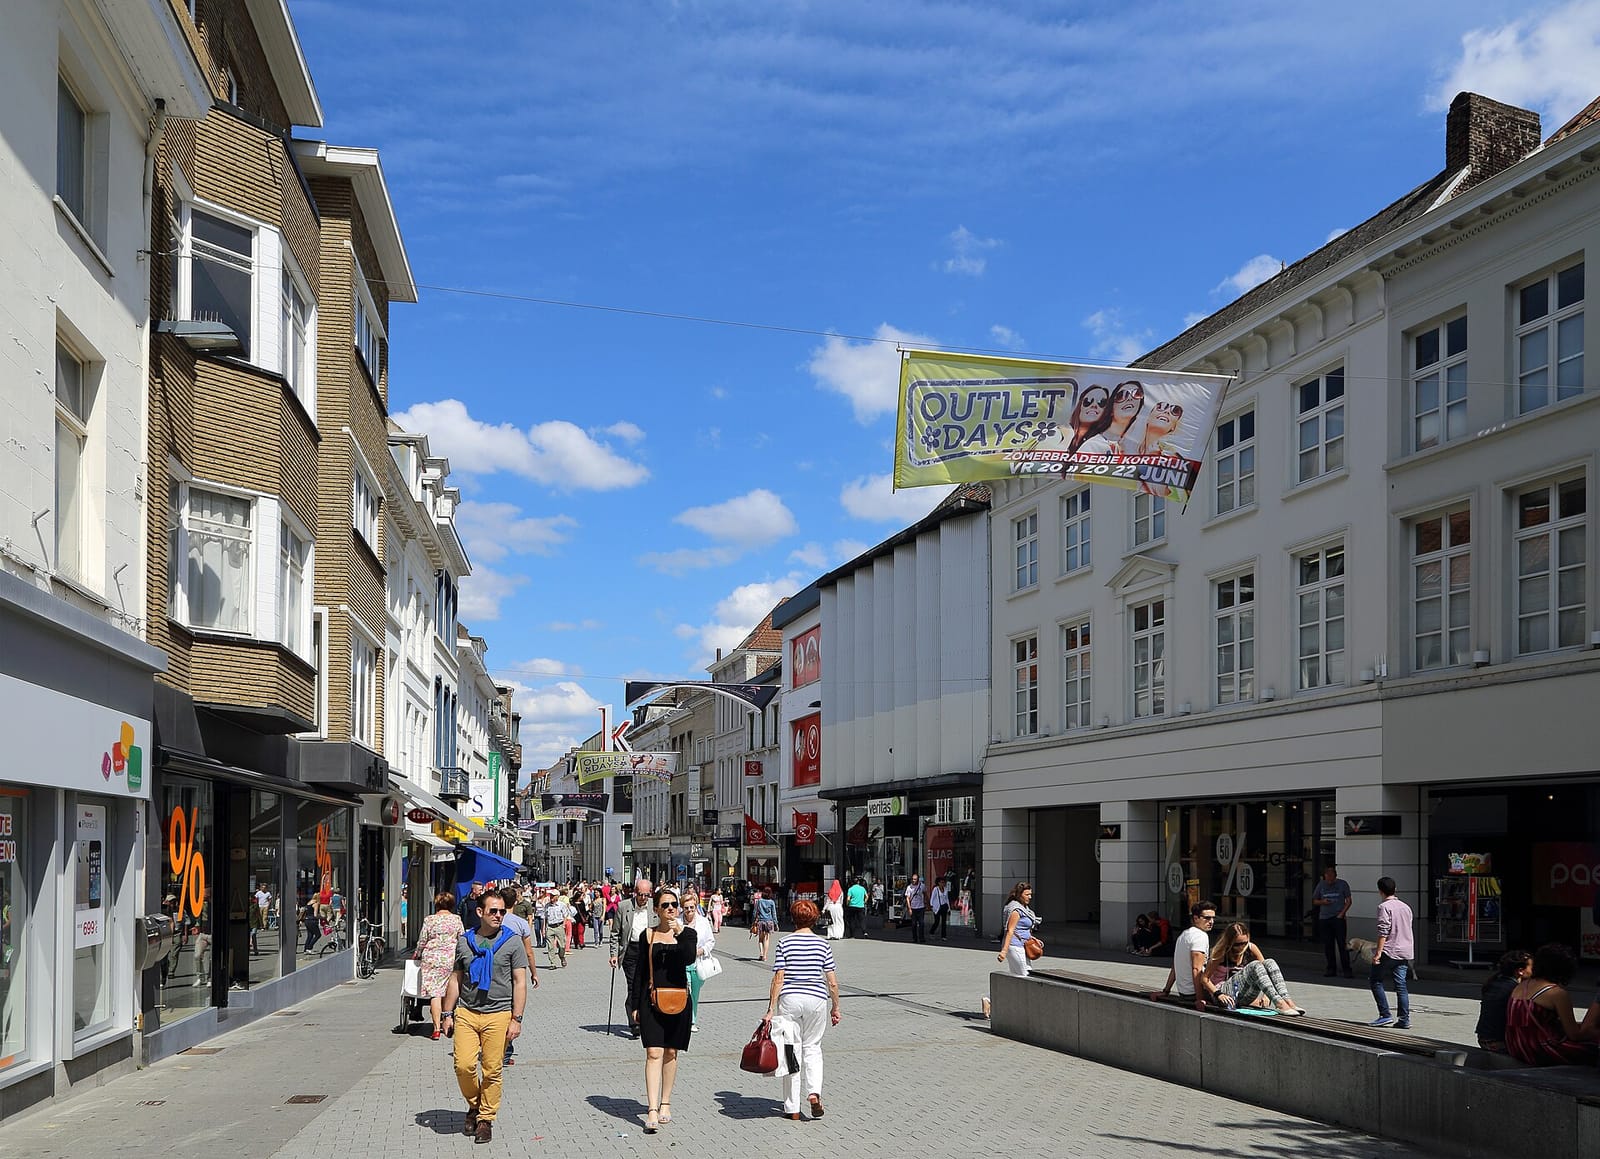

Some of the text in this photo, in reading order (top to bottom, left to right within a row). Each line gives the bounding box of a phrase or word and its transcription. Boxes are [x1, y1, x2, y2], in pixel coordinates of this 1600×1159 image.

[920, 390, 1065, 422] OUTLET
[943, 421, 1033, 450] DAYS
[1002, 451, 1190, 472] ZOMERBRADERIE KORTRIJK
[1009, 462, 1034, 474] VR
[1037, 463, 1063, 473] 20
[1080, 464, 1109, 474] ZO
[1112, 465, 1136, 477] 22
[1139, 467, 1187, 487] JUNI
[583, 755, 627, 767] OUTLET
[591, 761, 620, 771] DAYS
[472, 795, 483, 813] S
[869, 800, 891, 815] veritas
